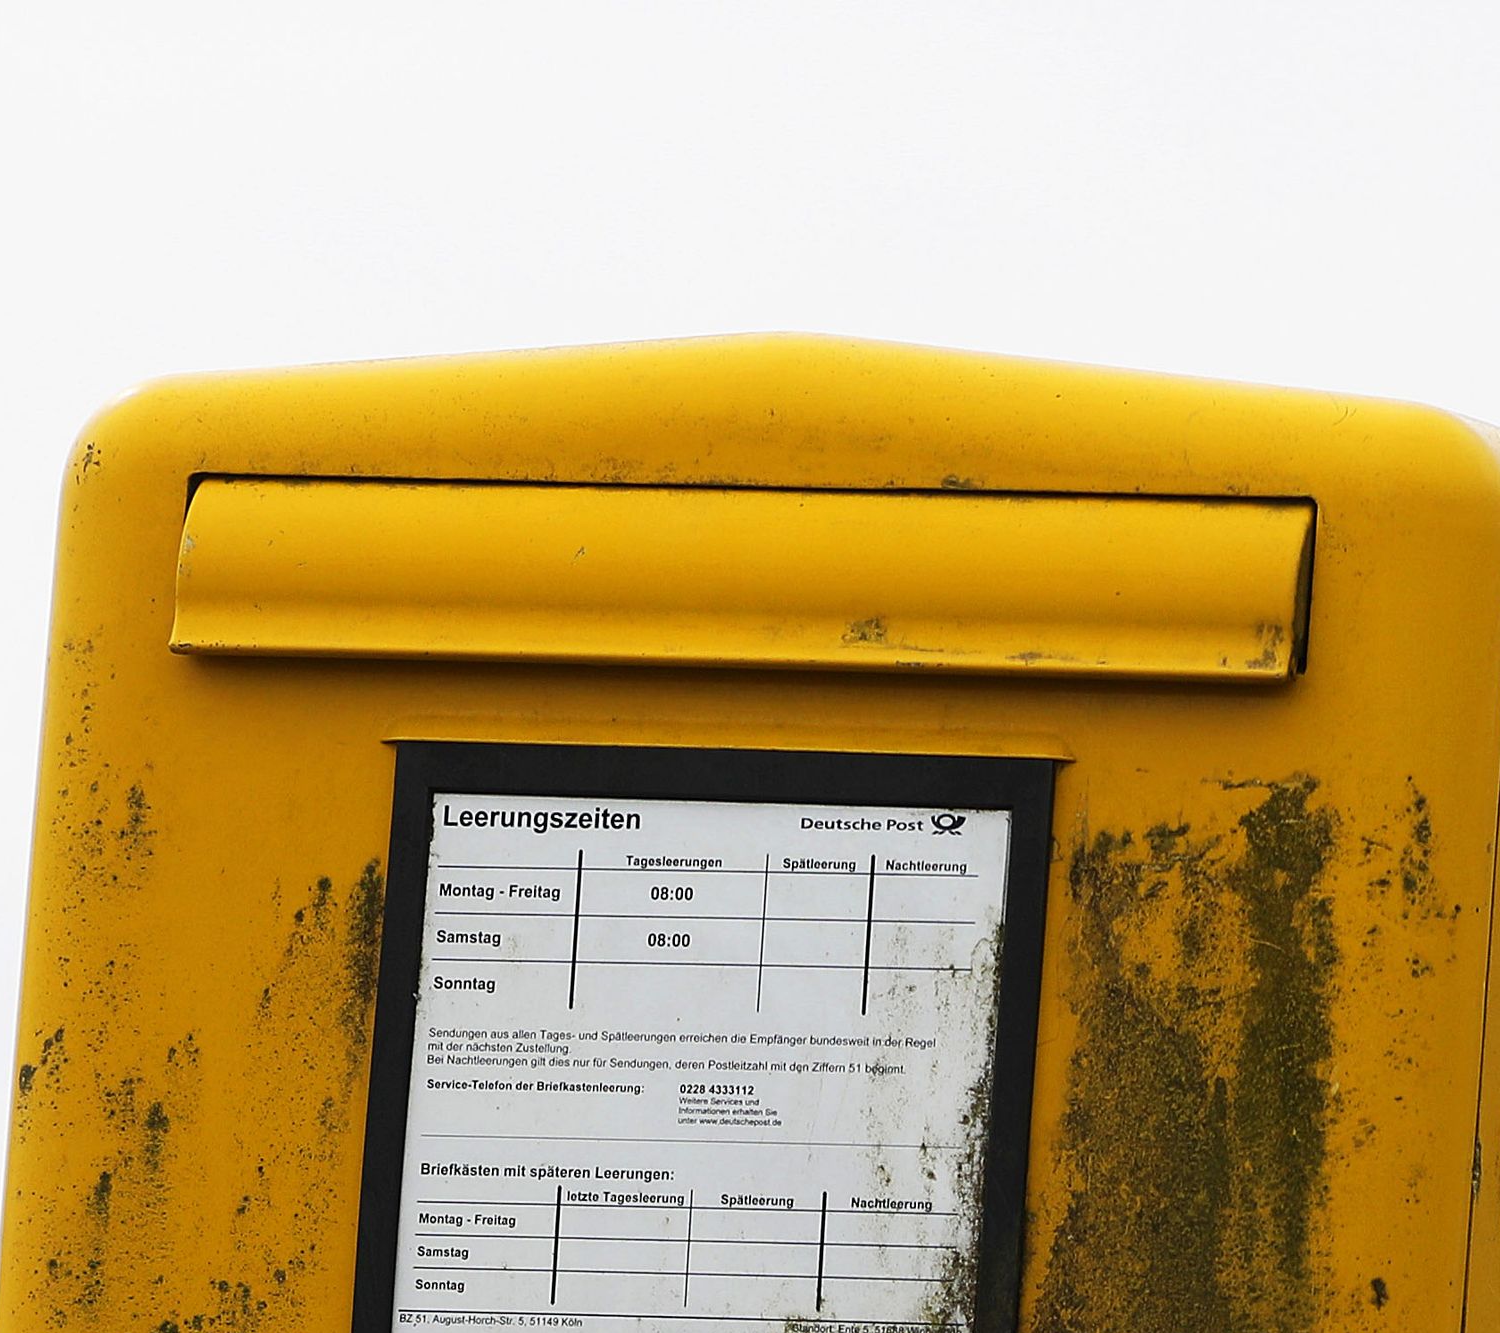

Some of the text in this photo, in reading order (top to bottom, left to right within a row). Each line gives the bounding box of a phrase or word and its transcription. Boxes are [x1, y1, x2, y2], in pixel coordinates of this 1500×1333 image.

[443, 805, 641, 834] Leerungszeiten
[800, 817, 924, 832] Deutsche Post
[626, 855, 723, 870] Tagesleerungen
[783, 857, 856, 872] Spätleerung
[885, 860, 968, 874] Nachtleerung
[439, 883, 495, 900] Montag
[509, 884, 561, 901] Freitag
[650, 886, 694, 900] 08:00
[435, 930, 501, 947] Samstag
[647, 933, 691, 947] 08:00
[433, 976, 496, 994] Sonntag
[428, 1028, 936, 1050] Sendungen aus allen Tages- und Spätleerungen erreichen die Empfänger bundesweit in der Regel
[427, 1042, 572, 1056] mit der nächsten Zustellung.
[427, 1055, 444, 1065] Bei
[446, 1055, 528, 1068] Nachtleerungen
[530, 1057, 546, 1069] gilt
[548, 1057, 570, 1067] dies
[572, 1059, 590, 1068] nur
[592, 1057, 608, 1068] für
[609, 1058, 672, 1071] Sendungen,
[675, 1059, 705, 1070] deren
[708, 1060, 768, 1071] Postleitzahl
[770, 1061, 787, 1071] mit
[789, 1061, 809, 1073] den
[811, 1062, 846, 1073] Ziffern
[849, 1063, 862, 1073] 51
[427, 1079, 645, 1095] Service-Telefon der Briefkastenleerung:
[679, 1084, 755, 1096] 0228 4333112
[678, 1097, 760, 1107] Weitere Services und
[678, 1107, 778, 1117] Informationen erhalten Sie
[677, 1117, 782, 1128] unter www.deutschepost.de
[420, 1163, 675, 1182] Briefkästen mit späteren Leerungen:
[566, 1191, 685, 1206] letzte Tagesleerung
[720, 1193, 794, 1209] Spätleerung
[851, 1197, 933, 1212] Nachtleerung
[418, 1213, 463, 1227] Montag
[474, 1214, 516, 1228] Freitag
[417, 1246, 469, 1260] Samstag
[415, 1279, 465, 1293] Sonntag
[399, 1313, 413, 1323] BZ
[432, 1315, 515, 1327] August-Horch-Str.
[529, 1317, 559, 1327] 51149
[561, 1318, 583, 1327] Köln
